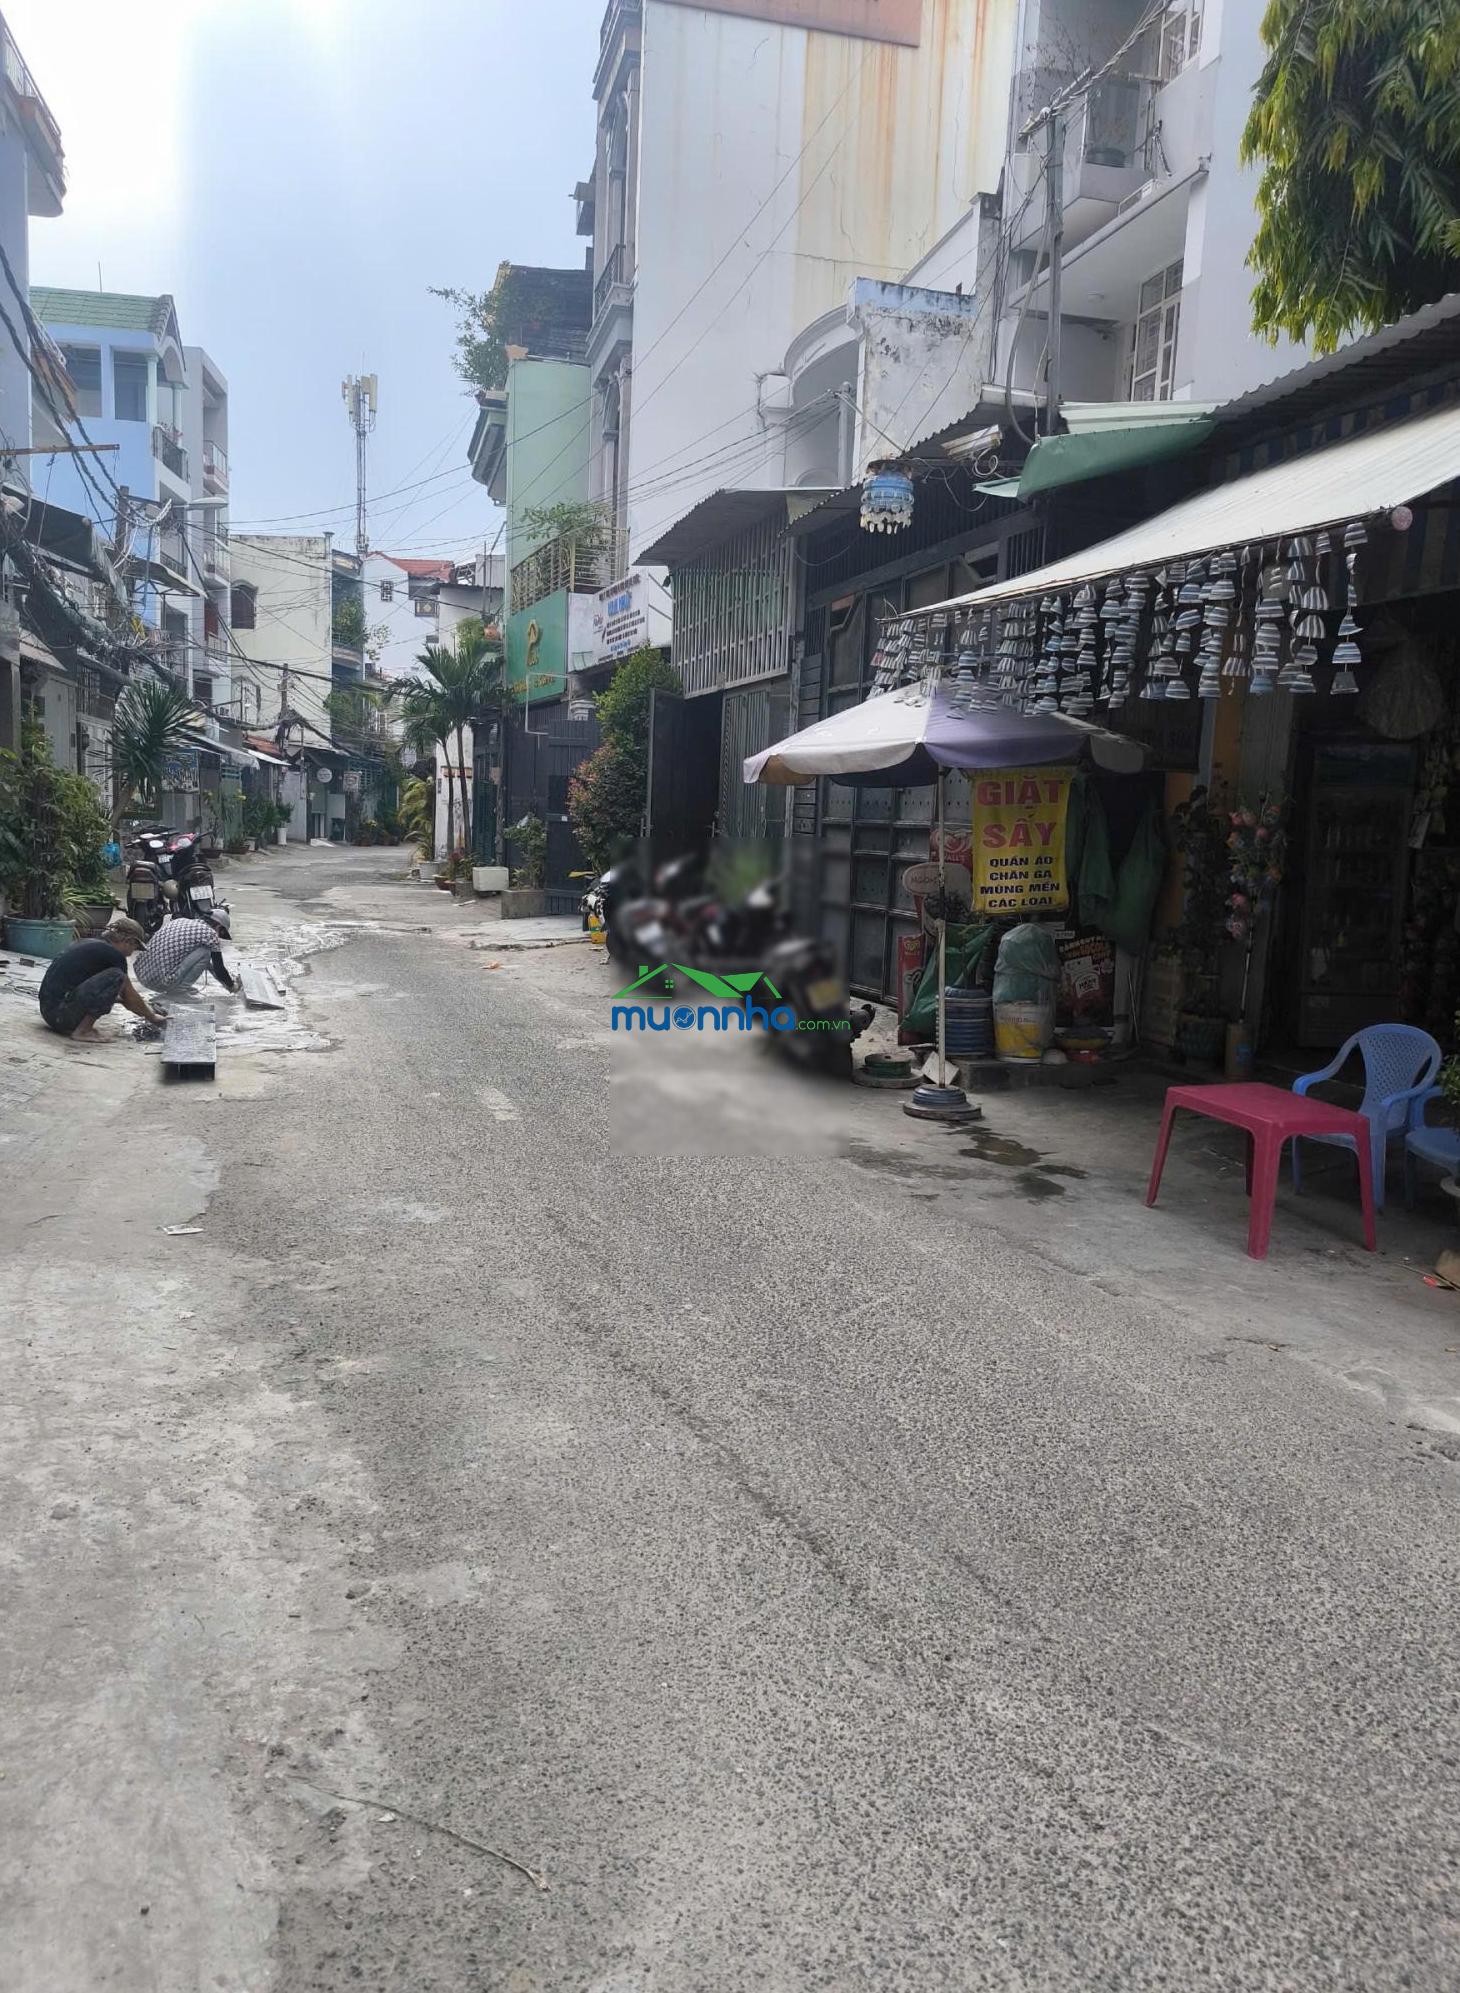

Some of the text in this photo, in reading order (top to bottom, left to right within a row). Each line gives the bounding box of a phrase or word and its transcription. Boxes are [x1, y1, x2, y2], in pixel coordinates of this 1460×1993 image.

[977, 775, 1065, 809] GIẶT
[983, 814, 1057, 848] SẤY
[1034, 869, 1053, 879] GA
